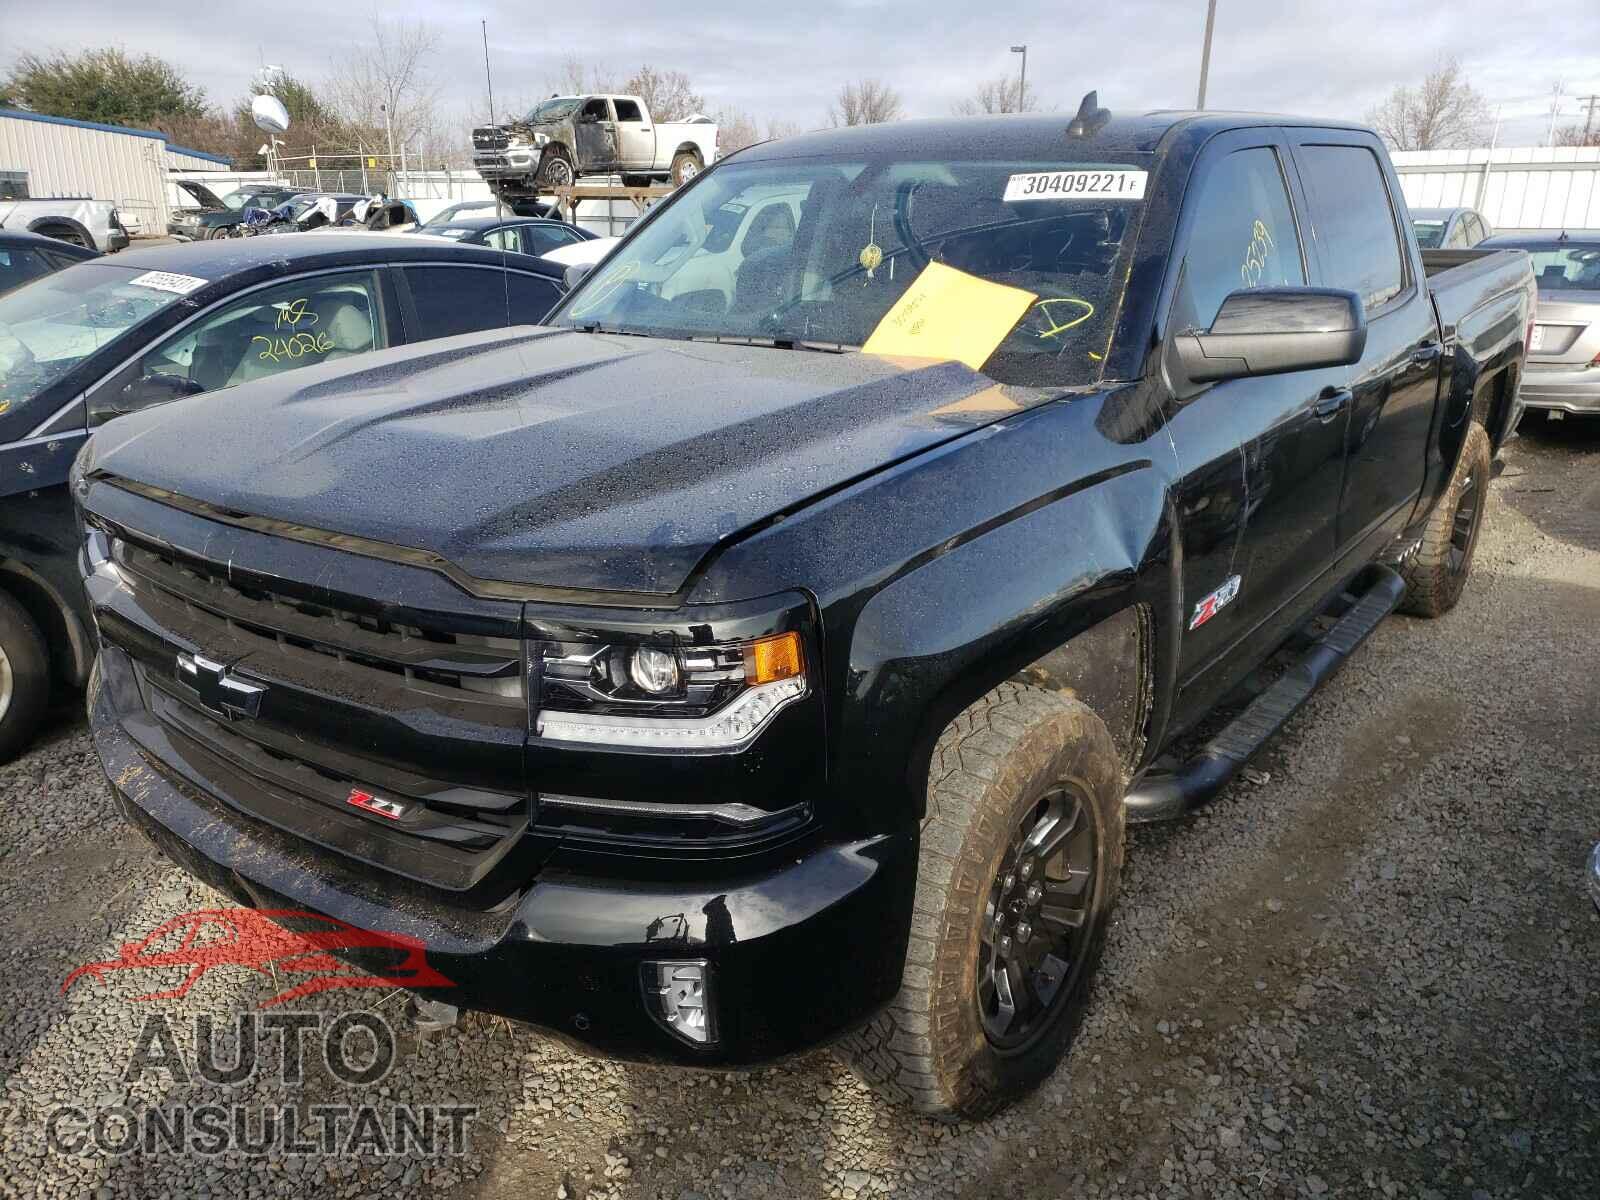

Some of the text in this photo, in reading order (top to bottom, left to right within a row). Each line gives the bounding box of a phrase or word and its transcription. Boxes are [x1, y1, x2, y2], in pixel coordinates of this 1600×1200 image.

[1024, 174, 1126, 194] 30409221
[252, 332, 336, 362] 24026
[346, 788, 404, 820] Z71
